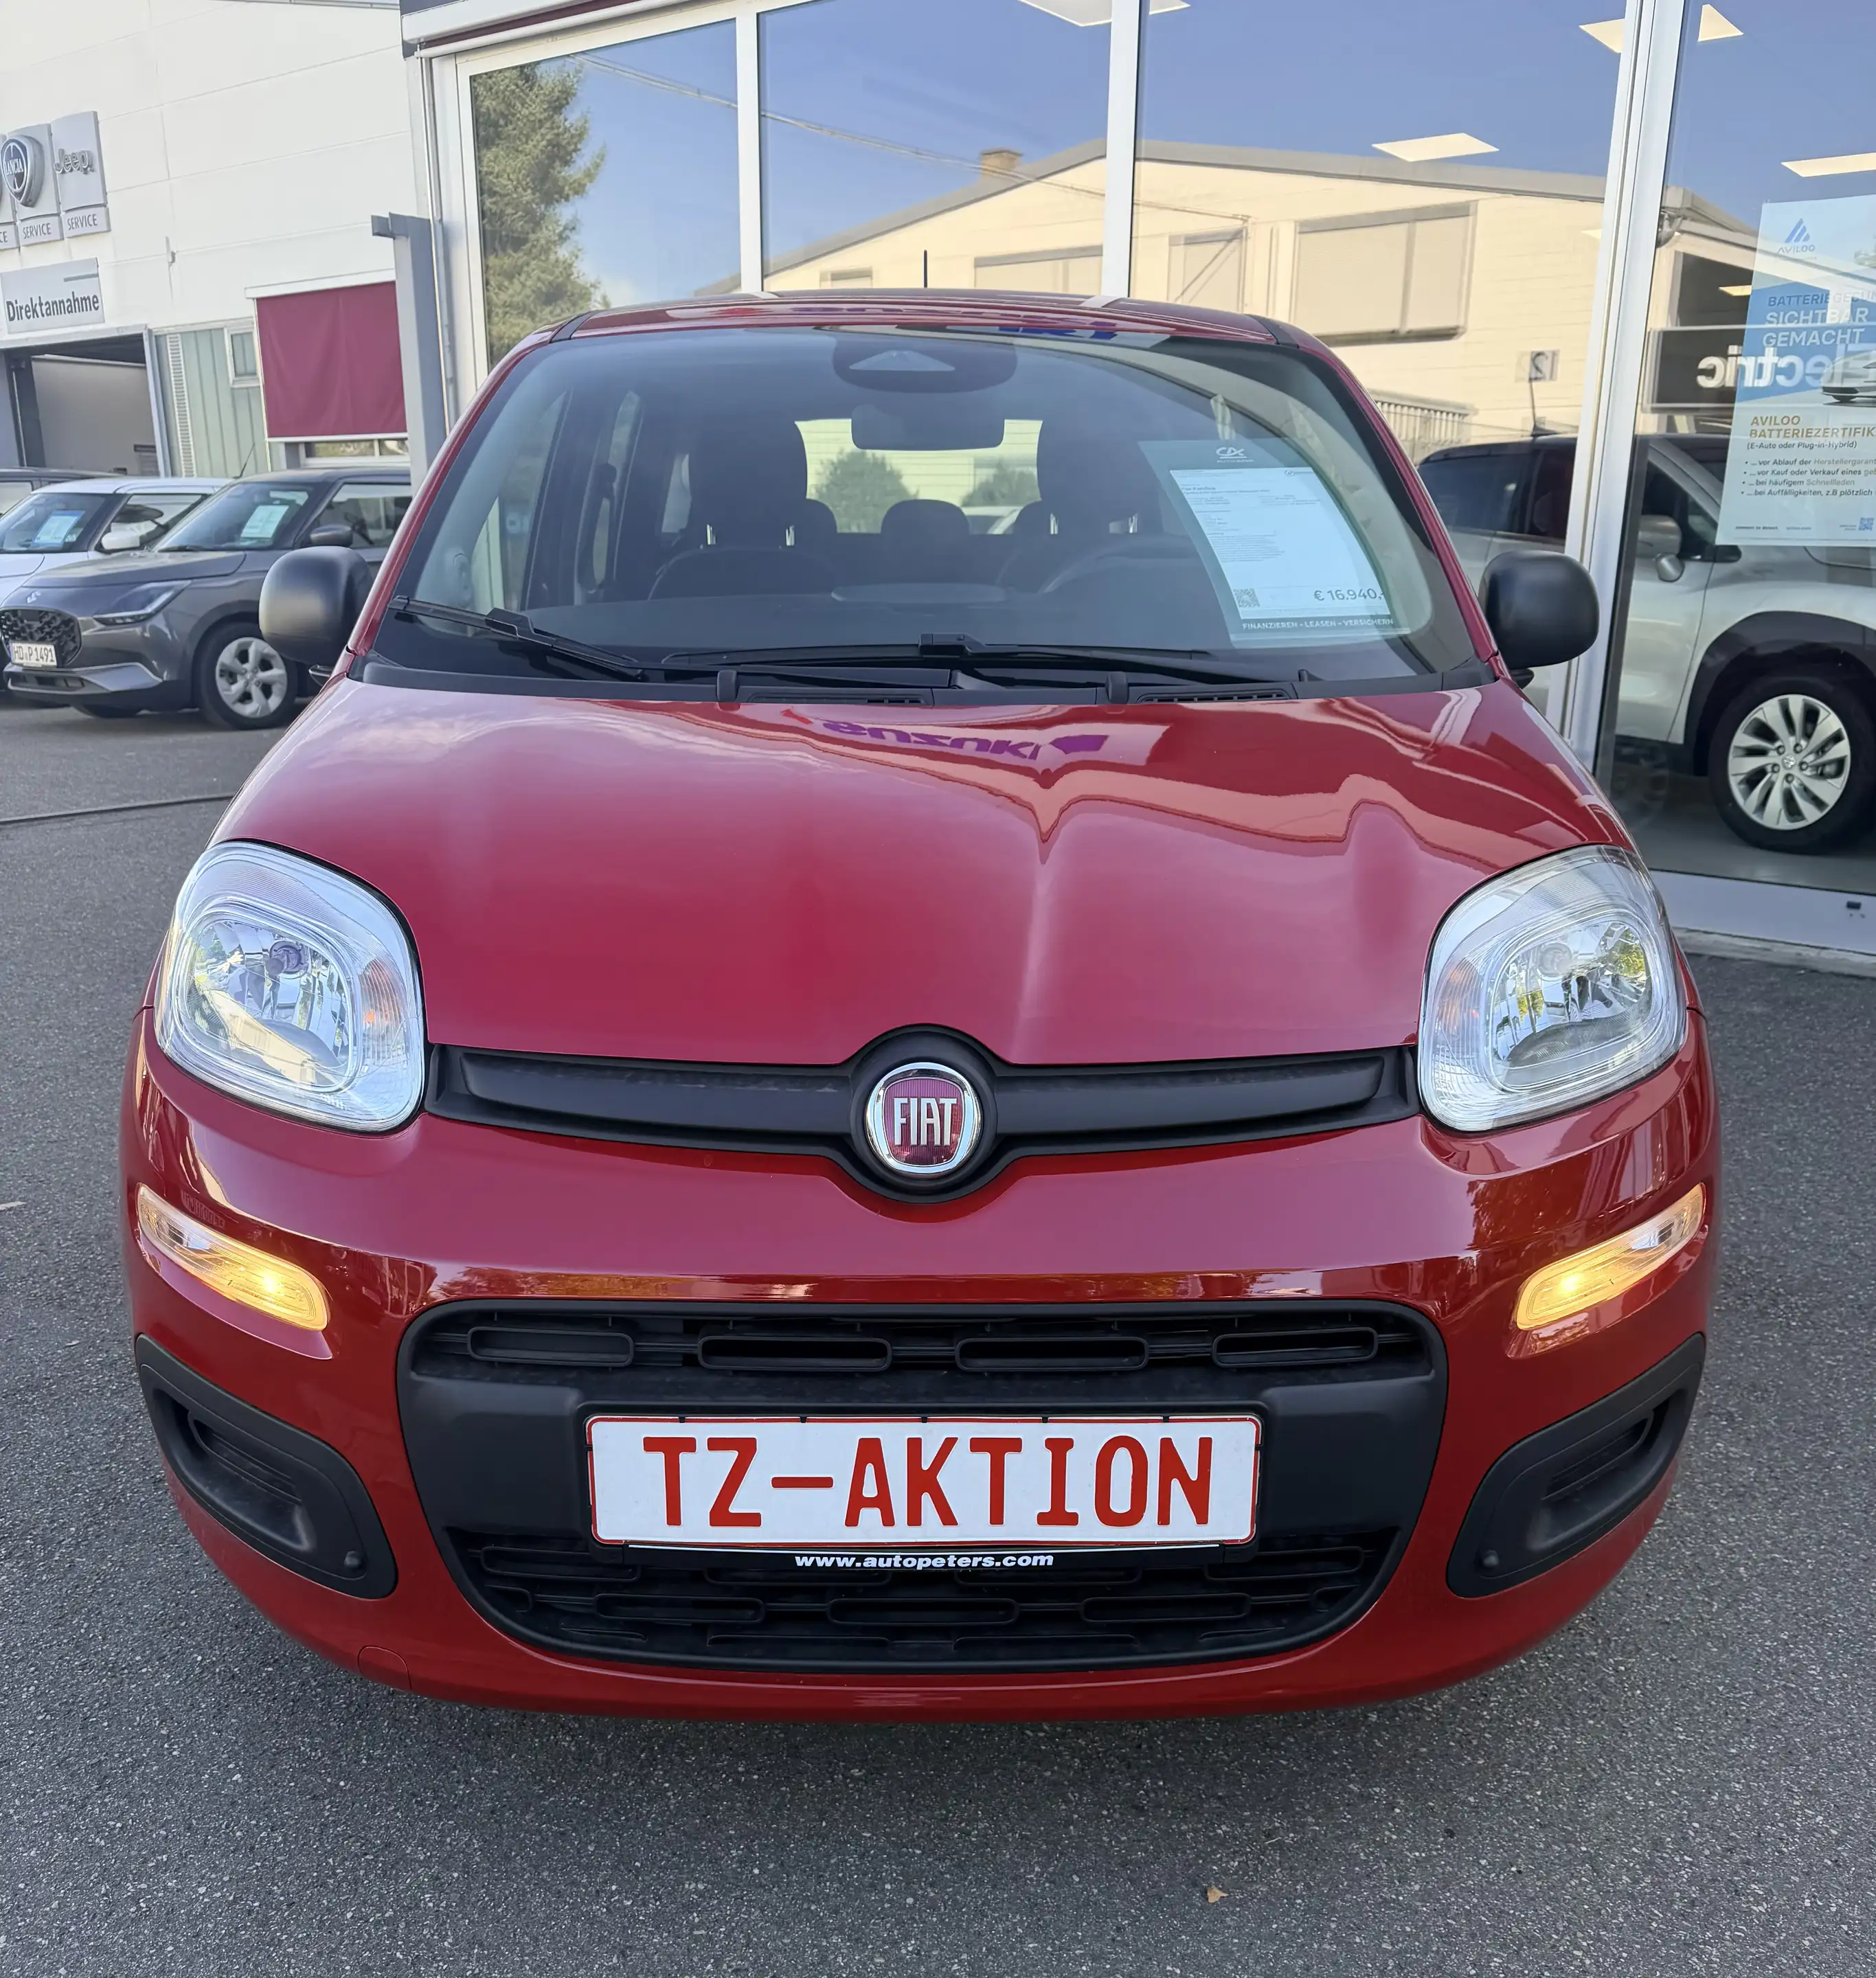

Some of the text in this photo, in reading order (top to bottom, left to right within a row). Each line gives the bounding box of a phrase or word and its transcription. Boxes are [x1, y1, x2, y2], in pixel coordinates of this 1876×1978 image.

[4, 158, 23, 175] LANCIA
[54, 148, 93, 174] Jeep
[67, 214, 98, 230] SERVICE
[23, 223, 52, 239] SERVICE
[1777, 245, 1815, 253] AVILOO
[5, 291, 100, 321] Direktannahme
[1765, 308, 1869, 327] SICHTBAR
[1763, 328, 1866, 347] GEMACHT
[1750, 415, 1801, 426] AVILOO
[1749, 427, 1876, 439] BATTERIEZERTIFIK
[1839, 488, 1873, 497] plötzlich
[1313, 590, 1325, 601] €
[1242, 622, 1298, 630] FINANZIEREN
[1343, 618, 1394, 626] VERSICHERN
[34, 646, 55, 663] 1491
[894, 1097, 957, 1147] FIAT
[642, 1435, 1213, 1527] TZ-AKTION
[795, 1554, 1054, 1571] www.autopeters.com
